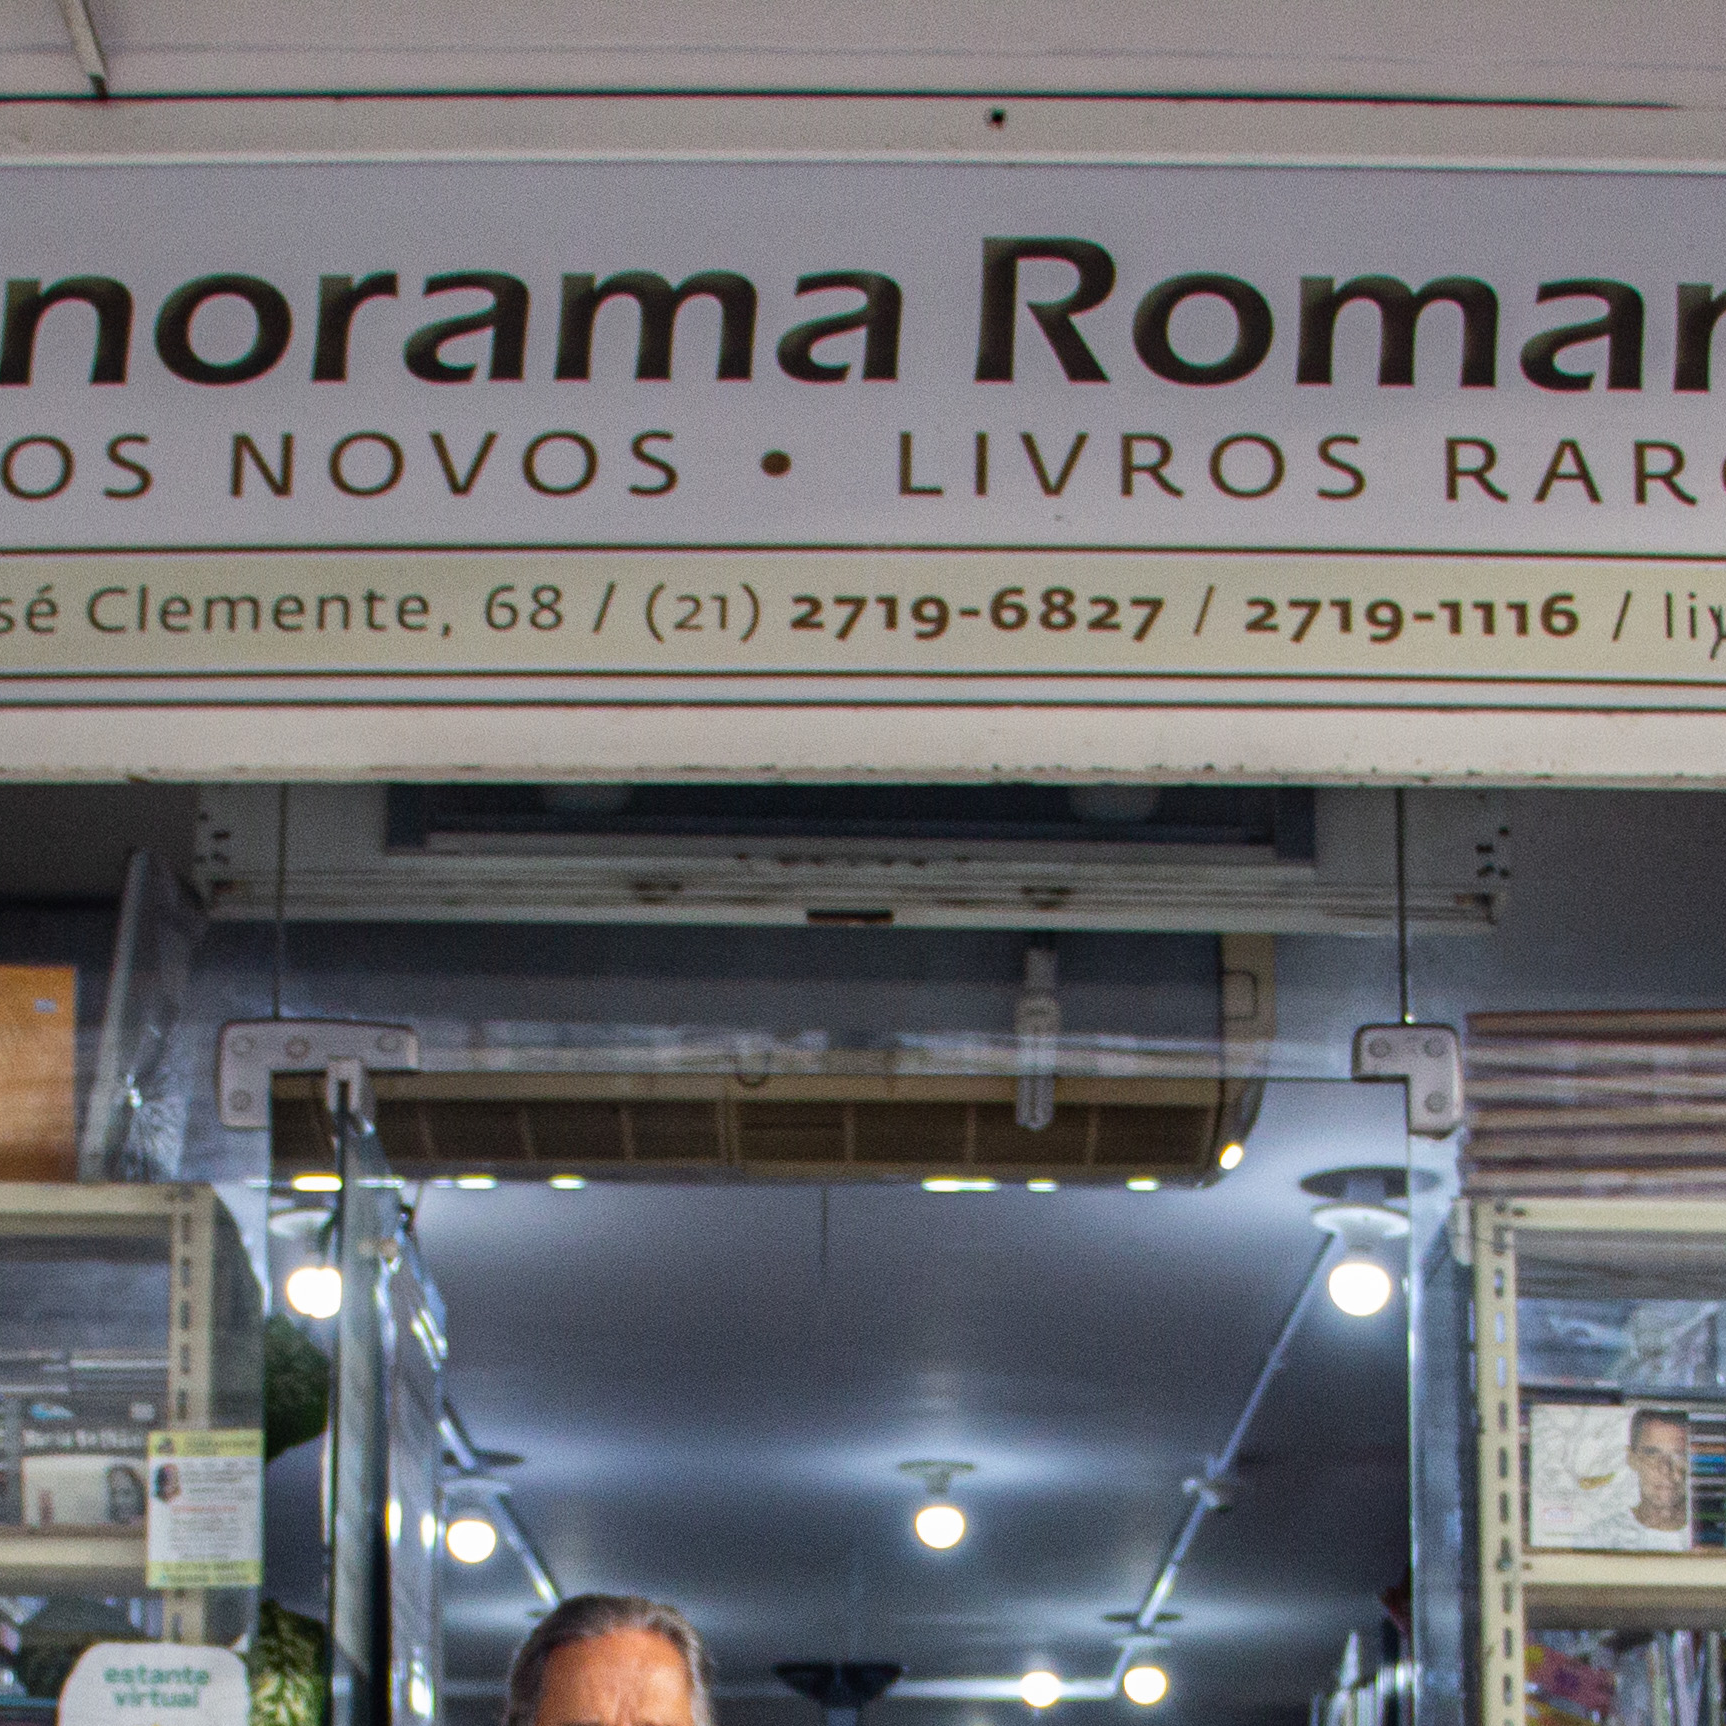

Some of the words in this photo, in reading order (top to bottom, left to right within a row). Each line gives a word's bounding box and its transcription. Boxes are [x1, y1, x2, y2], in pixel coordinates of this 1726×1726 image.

[229, 429, 679, 499] NOVOS
[897, 430, 1367, 501] LIVROS
[85, 583, 453, 638] Clemente,
[483, 583, 565, 633] 68
[643, 578, 762, 644] (21)
[789, 583, 1165, 643] 2719-6827
[1244, 592, 1580, 645] 2719-1116
